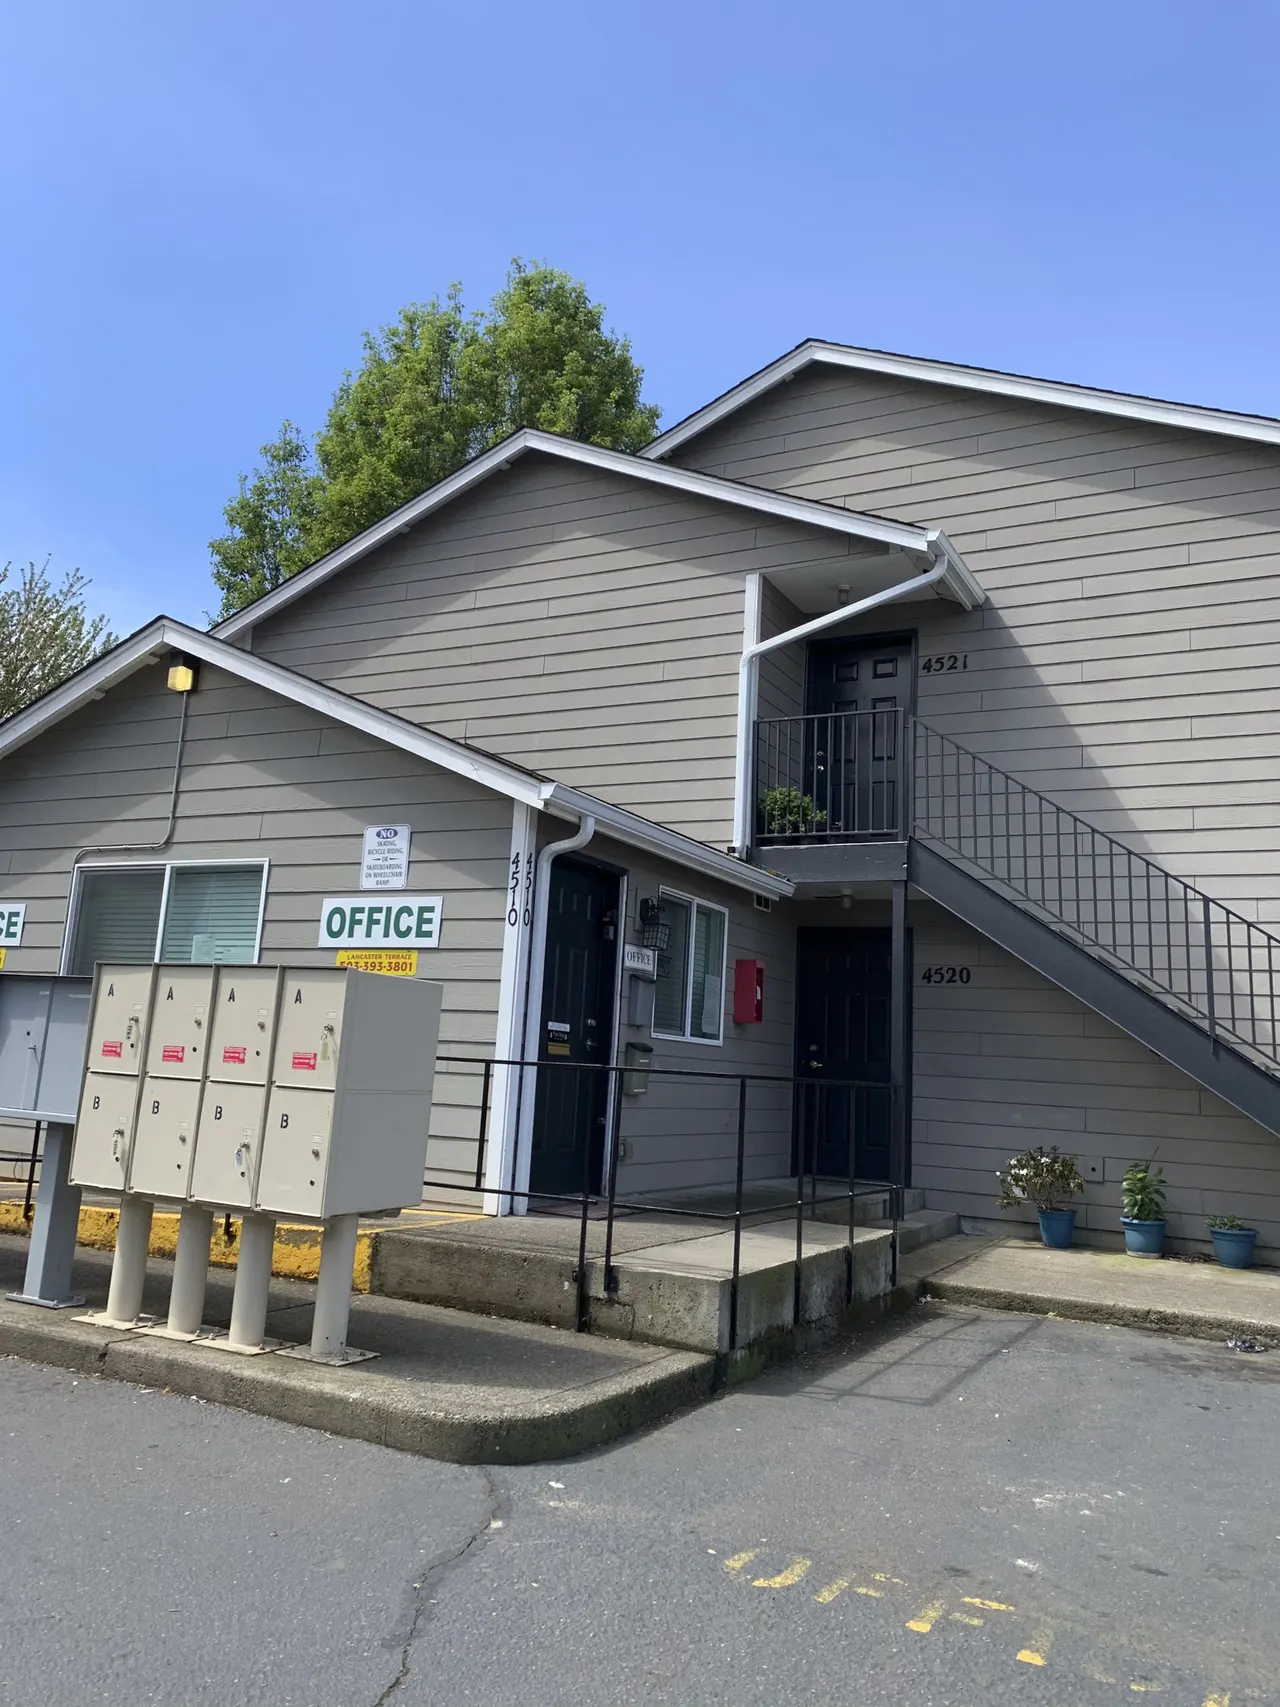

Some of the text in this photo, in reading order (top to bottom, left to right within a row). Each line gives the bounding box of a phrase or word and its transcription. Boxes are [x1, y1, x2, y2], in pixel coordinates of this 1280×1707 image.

[922, 654, 968, 673] 4521
[379, 829, 395, 839] NO
[508, 852, 520, 926] 4510
[523, 852, 533, 926] 4510
[326, 905, 436, 939] OFFICE
[626, 951, 652, 966] OFFICE
[922, 967, 971, 984] 4520
[107, 984, 115, 997] A
[166, 986, 174, 1000] A
[228, 987, 235, 1002] A
[294, 988, 302, 1004] A
[92, 1096, 100, 1110] B
[151, 1100, 160, 1115] B
[214, 1105, 223, 1120] B
[280, 1113, 289, 1129] B
